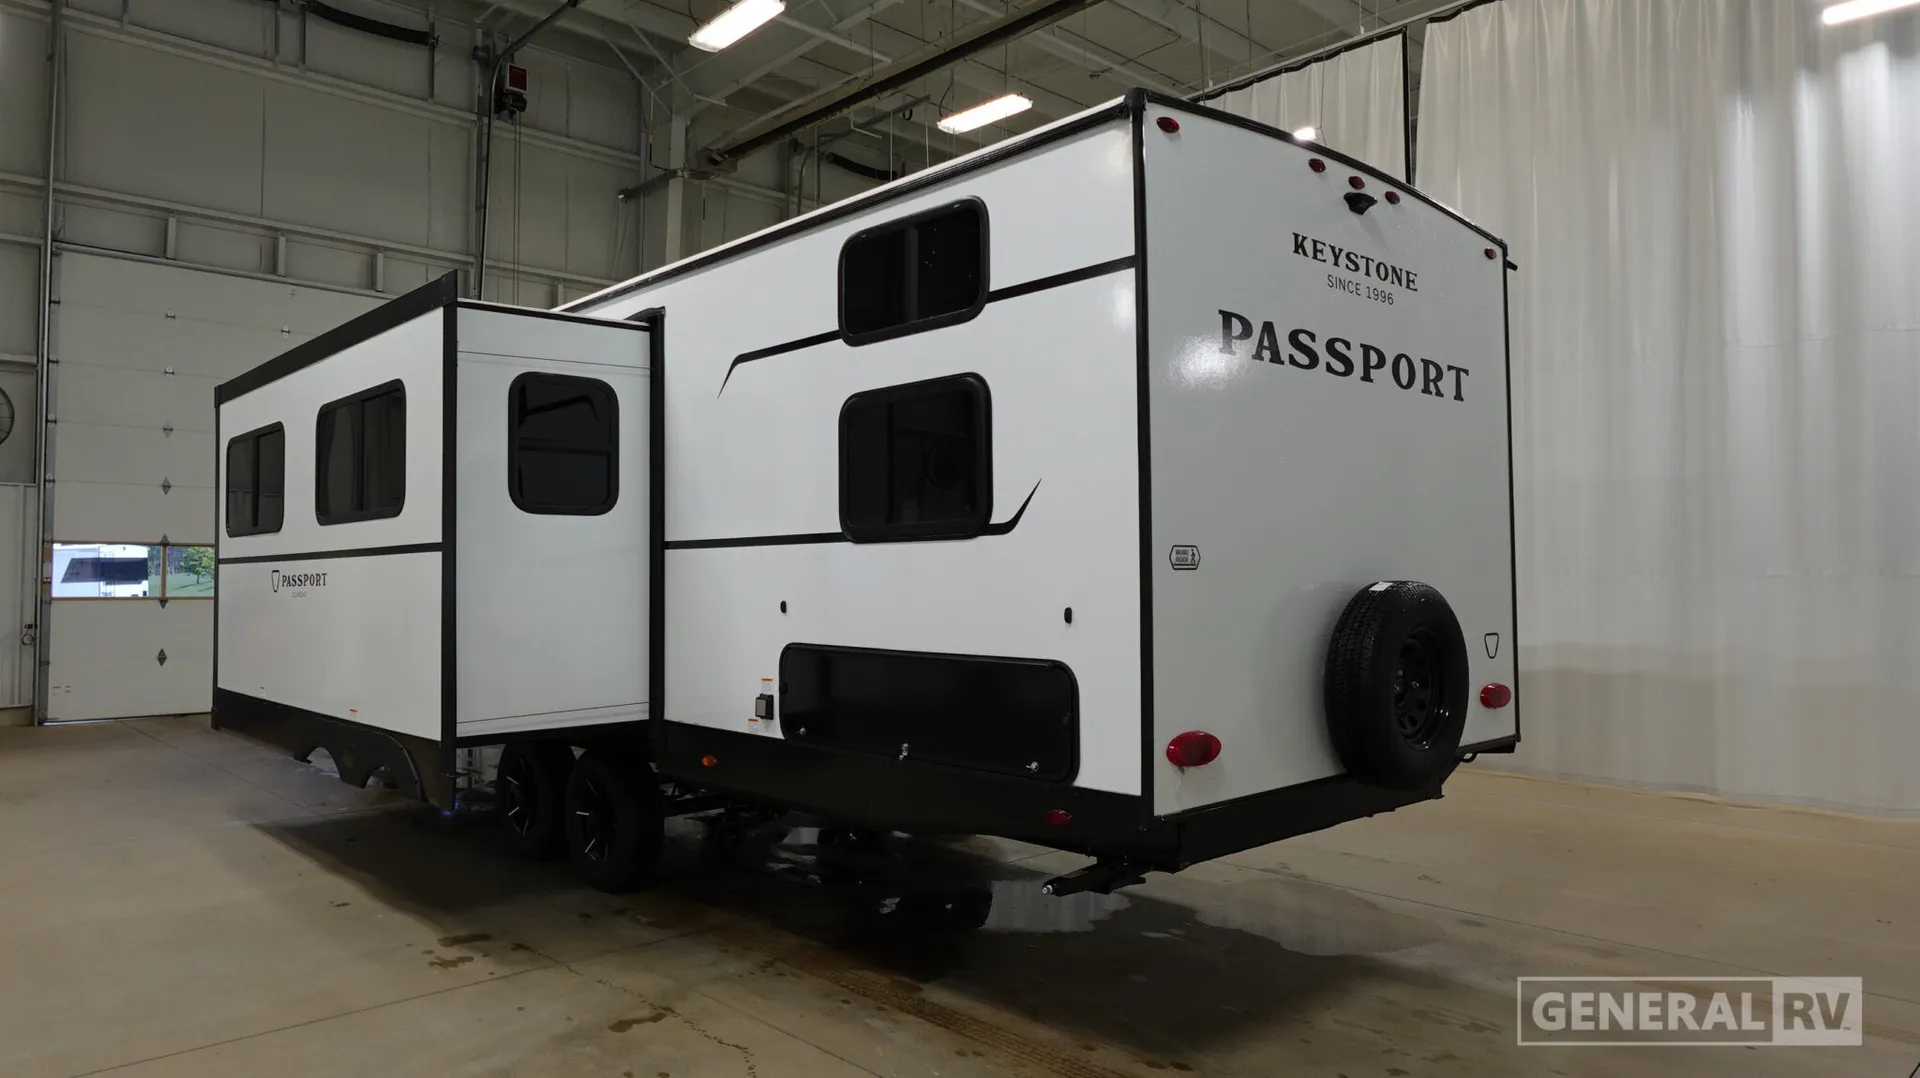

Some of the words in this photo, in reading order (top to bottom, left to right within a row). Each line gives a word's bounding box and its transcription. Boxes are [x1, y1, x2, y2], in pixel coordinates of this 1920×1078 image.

[1292, 232, 1418, 292] KEYSTONE
[1327, 274, 1361, 296] SINCE
[1366, 286, 1394, 305] 1996
[1218, 309, 1469, 402] PASSPORT
[282, 573, 328, 587] PASSPORT
